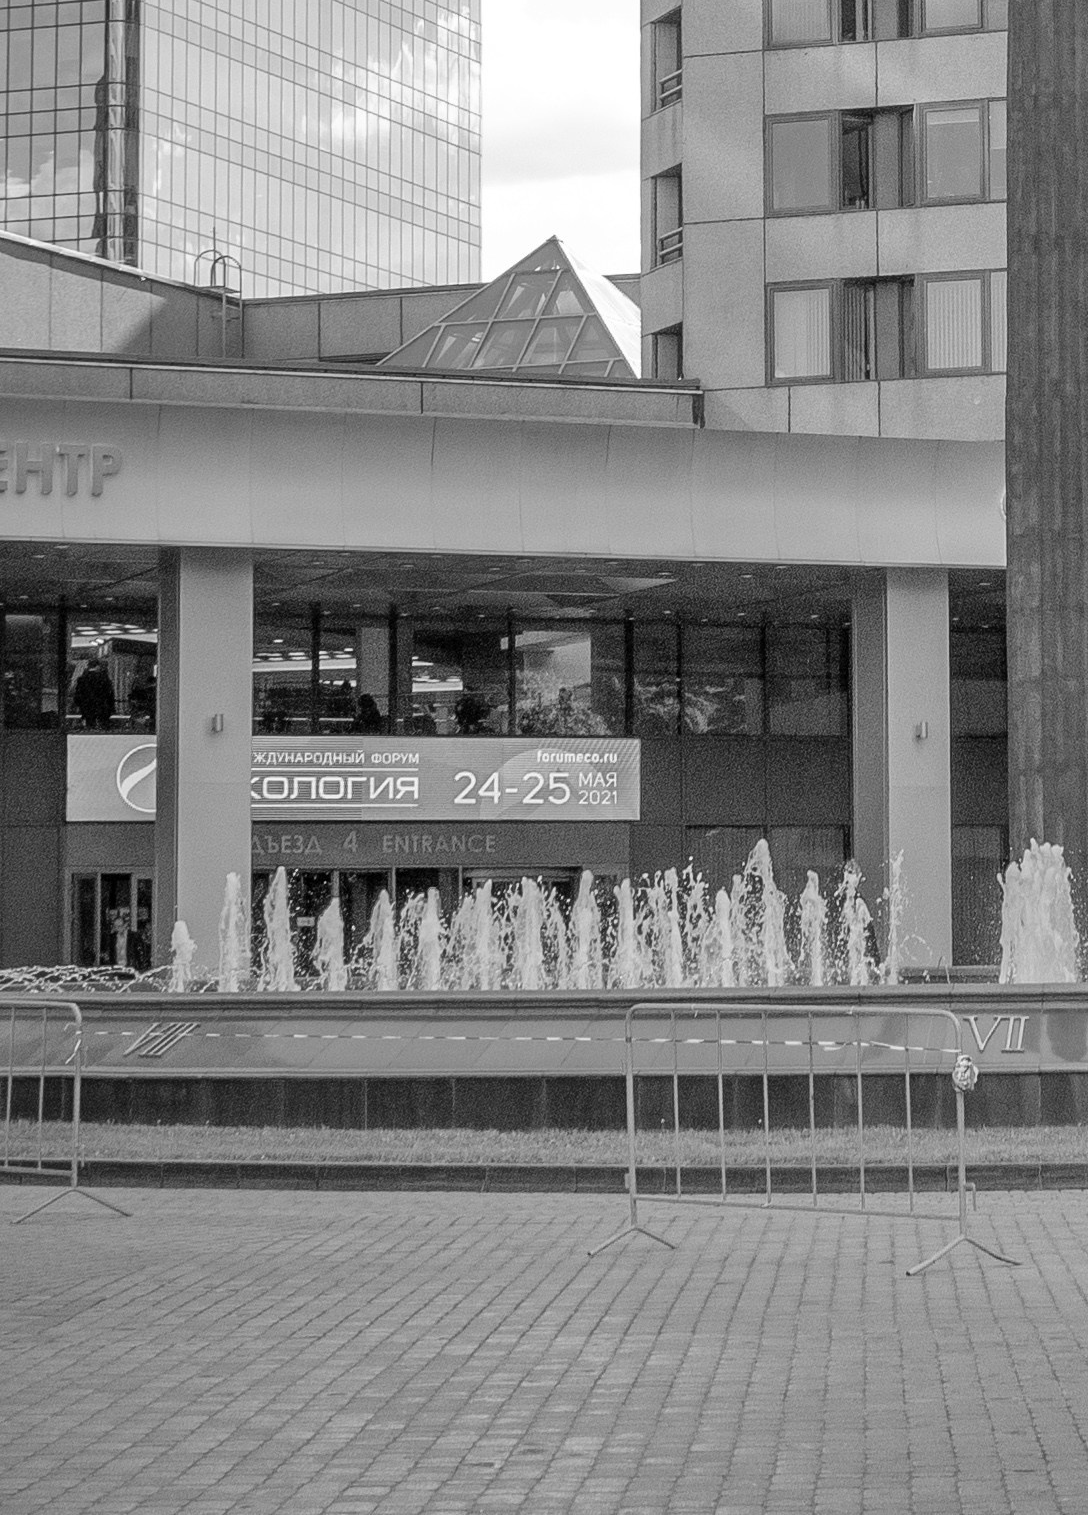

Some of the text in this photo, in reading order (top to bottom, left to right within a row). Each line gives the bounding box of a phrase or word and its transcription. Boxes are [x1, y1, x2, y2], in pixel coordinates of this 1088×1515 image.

[252, 750, 419, 766] ЖДУНАРОДНЫЙ ФОРУМ
[536, 750, 617, 763] forumeco.ru
[251, 776, 419, 800] ОЛОГИЯ
[454, 771, 617, 805] 24-25 МАЯ
[578, 790, 618, 805] 2021
[252, 831, 496, 855] ДЪЕЗД 4 ENTRANCE
[963, 1015, 1029, 1053] VII
